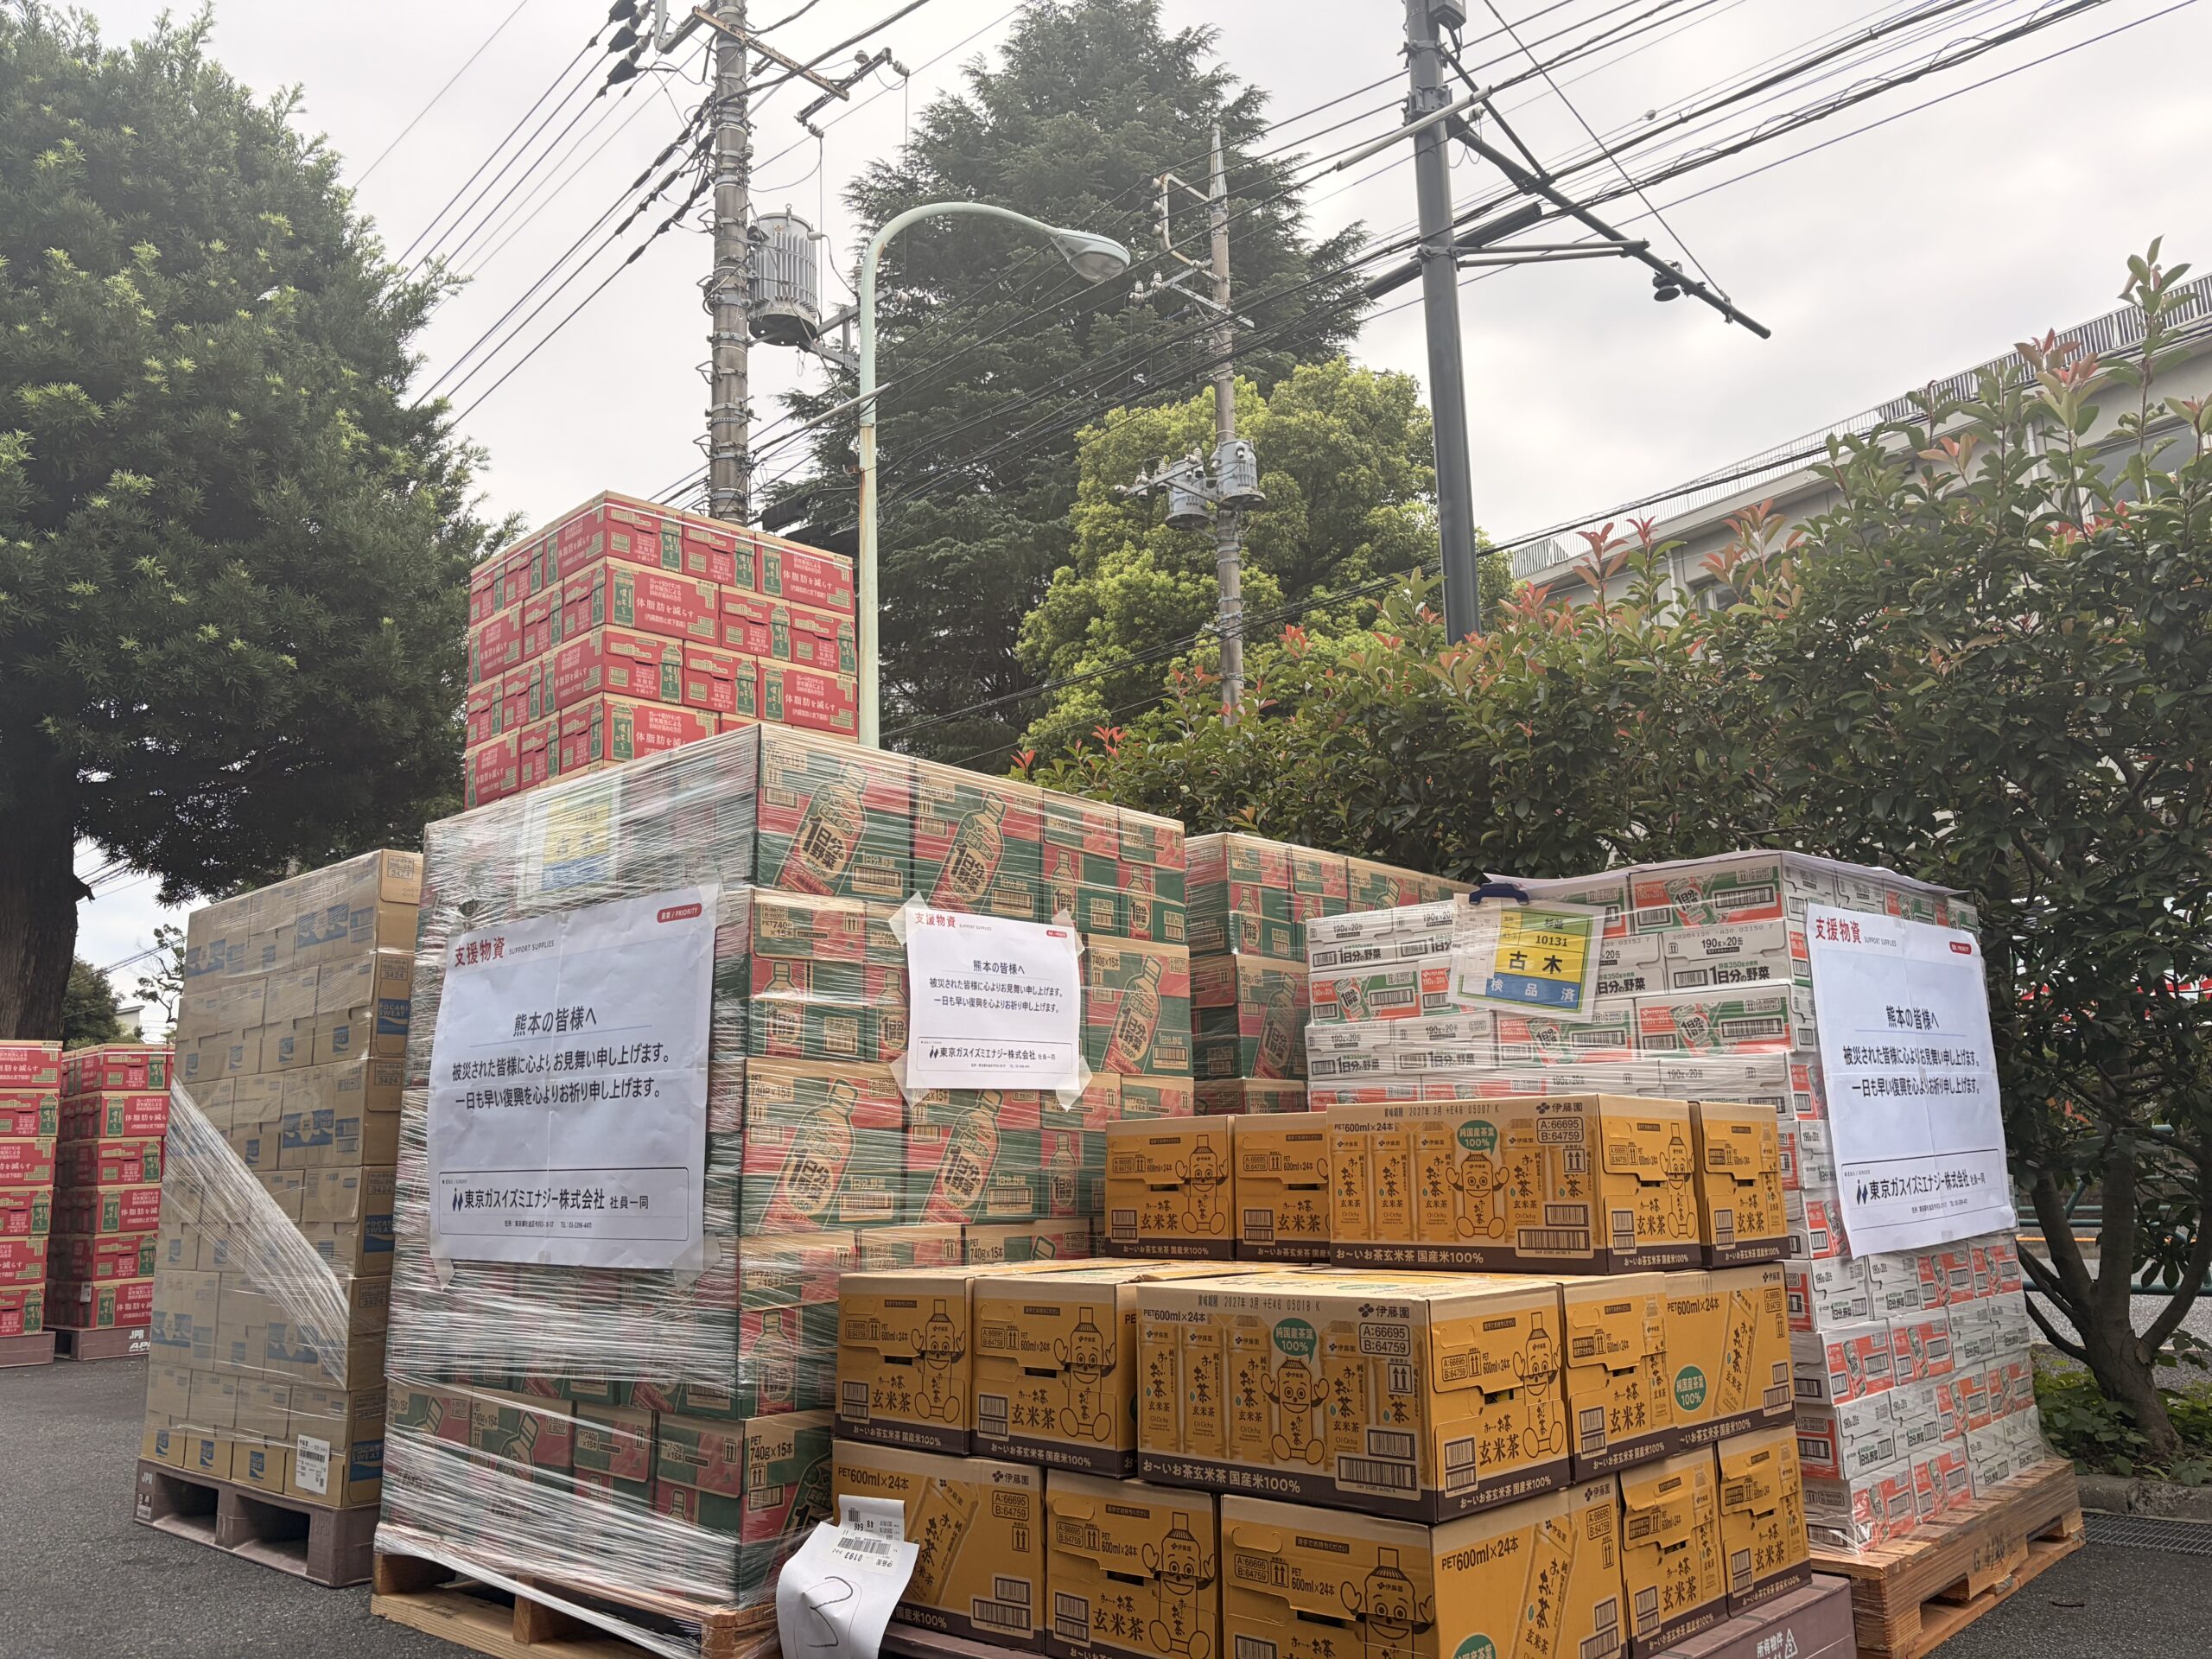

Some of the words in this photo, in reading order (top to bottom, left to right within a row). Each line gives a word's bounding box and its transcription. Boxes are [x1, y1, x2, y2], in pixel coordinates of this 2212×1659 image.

[783, 569, 833, 589] 体脂肪を減らす
[636, 597, 694, 619] 体脂肪を減らす
[785, 694, 836, 711] 体脂肪を減らす
[636, 732, 686, 747] 体脂肪を減
[676, 907, 698, 917] PRIORITY
[915, 912, 956, 928] 支援物資
[1815, 916, 1861, 944] 支援物資
[1881, 938, 1897, 947] SUPPLIES
[1535, 936, 1567, 947] 10131
[1701, 937, 1743, 948] 190g×20缶
[454, 937, 505, 967] 支援物資
[509, 944, 531, 956] SUPPORT
[532, 940, 554, 950] SUPPLIES
[1338, 948, 1381, 963] 1日分の野菜
[973, 960, 1025, 974] 熊本の皆様へ
[1092, 956, 1119, 969] 740g×15本
[1510, 951, 1562, 974] 古木
[1709, 967, 1770, 984] 1日分の野菜
[930, 978, 1062, 997] 被災された皆様に心よりお見舞い申し上げます。
[1491, 978, 1574, 1001] 検品済
[1599, 978, 1645, 994] 日分の野菜
[379, 1002, 410, 1011] POCARI
[934, 997, 1058, 1013] 一日も早い復興を心よりお祈り申し上げます。
[513, 1006, 596, 1037] 熊本の皆様へ
[1886, 1005, 1940, 1030] 熊本の皆様へ
[1120, 1007, 1147, 1052] 1日分の野菜
[939, 1047, 1036, 1059] 東京ガスイズミエナジー株式会社
[1843, 1046, 1980, 1068] 被災された皆様に心よりお見舞い申し上げます。
[452, 1043, 669, 1081] 被災された皆様に心よりお見舞い申し上げます。
[1337, 1055, 1381, 1073] 1日分の野菜
[455, 1077, 659, 1110] 一日も早い復興を心よりお祈り申し上げます。
[1853, 1077, 1980, 1098] 一日も早い復興を心よりお祈り申し上げます。
[1409, 1106, 1430, 1116] 2027年
[1433, 1106, 1442, 1116] 3月
[1469, 1105, 1490, 1114] 05007
[1496, 1104, 1499, 1113] K
[1552, 1103, 1583, 1113] 伊藤園
[1334, 1122, 1393, 1132] PET600ml×24本
[1541, 1119, 1580, 1128] A:66695
[1459, 1127, 1495, 1138] 純国産茶葉
[1541, 1131, 1580, 1141] B:64759
[1465, 1138, 1490, 1147] 100%
[1283, 1162, 1313, 1171] 600ml×24本
[1869, 1170, 1969, 1200] 東京ガスイズミエナジー株式会社
[465, 1188, 604, 1210] 東京ガスイズミエナジー株式会社
[610, 1196, 648, 1210] 社員一同
[1340, 1199, 1361, 1208] 玄米茶
[1382, 1199, 1402, 1208] 玄米茶
[1426, 1199, 1447, 1208] 玄米茶
[1514, 1199, 1537, 1209] 玄米茶
[1140, 1213, 1178, 1230] 玄米茶
[1277, 1213, 1320, 1232] 玄米茶
[1637, 1215, 1666, 1236] 玄米茶
[1737, 1211, 1764, 1233] 玄米茶
[970, 1247, 1003, 1260] 740g×15本
[1171, 1246, 1209, 1255] 国産米100%
[1417, 1252, 1484, 1263] 国産米100%
[1662, 1254, 1688, 1264] 国産米100%
[1769, 1272, 1781, 1281] 伊藤園
[1224, 1296, 1245, 1308] 2027年
[1249, 1298, 1259, 1309] 3月
[1287, 1300, 1313, 1311] 05018
[1315, 1301, 1320, 1312] K
[1668, 1298, 1719, 1314] PET600ml×24本
[1143, 1309, 1206, 1323] PET600ml×24本
[1376, 1305, 1409, 1319] 伊藤園
[130, 1330, 144, 1339] JPR
[982, 1328, 1004, 1338] A:66695
[1275, 1327, 1313, 1340] 純国産茶葉
[1363, 1325, 1405, 1338] A:66695
[1020, 1339, 1050, 1352] 600ml×24本
[1281, 1340, 1308, 1351] 100%
[1364, 1340, 1406, 1353] B:64759
[1607, 1340, 1629, 1353] 600ml×24本
[1444, 1357, 1465, 1367] A:66695
[1483, 1360, 1510, 1375] 600ml×24本
[1445, 1369, 1465, 1378] B:64759
[1676, 1376, 1704, 1393] 純国産茶葉
[872, 1389, 911, 1413] 玄米茶
[1148, 1401, 1170, 1412] 玄米茶
[1681, 1393, 1700, 1406] 100%
[1011, 1403, 1055, 1429] 玄米茶
[1192, 1407, 1215, 1417] 玄米茶
[1239, 1411, 1262, 1422] 玄米茶
[1610, 1402, 1645, 1434] 玄米茶
[1333, 1421, 1359, 1433] 玄米茶
[1719, 1419, 1751, 1436] 国産米100%
[750, 1436, 762, 1446] PET
[902, 1432, 941, 1446] 国産米100%
[352, 1452, 379, 1461] SWEAT
[750, 1442, 792, 1462] 740g×15本
[1479, 1434, 1519, 1467] 玄米茶
[1634, 1441, 1665, 1458] 国産米100%
[1046, 1451, 1091, 1467] 国産米100%
[142, 1471, 152, 1484] JPR
[838, 1468, 909, 1491] PET600ml×24本
[1005, 1473, 1029, 1485] 伊藤園
[1230, 1471, 1300, 1493] 国産米100%
[1513, 1476, 1551, 1493] 国産米100%
[947, 1486, 964, 1506] 伊藤園
[1593, 1484, 1610, 1498] 伊藤園
[995, 1494, 1026, 1505] A:66695
[995, 1506, 1026, 1518] B:64759
[1058, 1524, 1080, 1535] A:66695
[1552, 1525, 1567, 1543] 伊藤園
[1059, 1534, 1081, 1545] B:64759
[1102, 1542, 1137, 1556] 600ml×24本
[1441, 1536, 1519, 1572] PET600ml×24本
[844, 1552, 863, 1561] 0193
[1237, 1557, 1266, 1570] A:66695
[1755, 1541, 1784, 1573] 玄米茶
[1237, 1567, 1266, 1580] B:64759
[1292, 1579, 1334, 1596] 600ml×24本
[1662, 1577, 1697, 1612] 玄米茶
[896, 1609, 946, 1628] 国産米100%
[1093, 1608, 1144, 1641] 玄米茶
[1686, 1614, 1713, 1632] 国産米100%
[1526, 1629, 1548, 1656] 玄米茶
[1757, 1631, 1783, 1659] 所有物件
